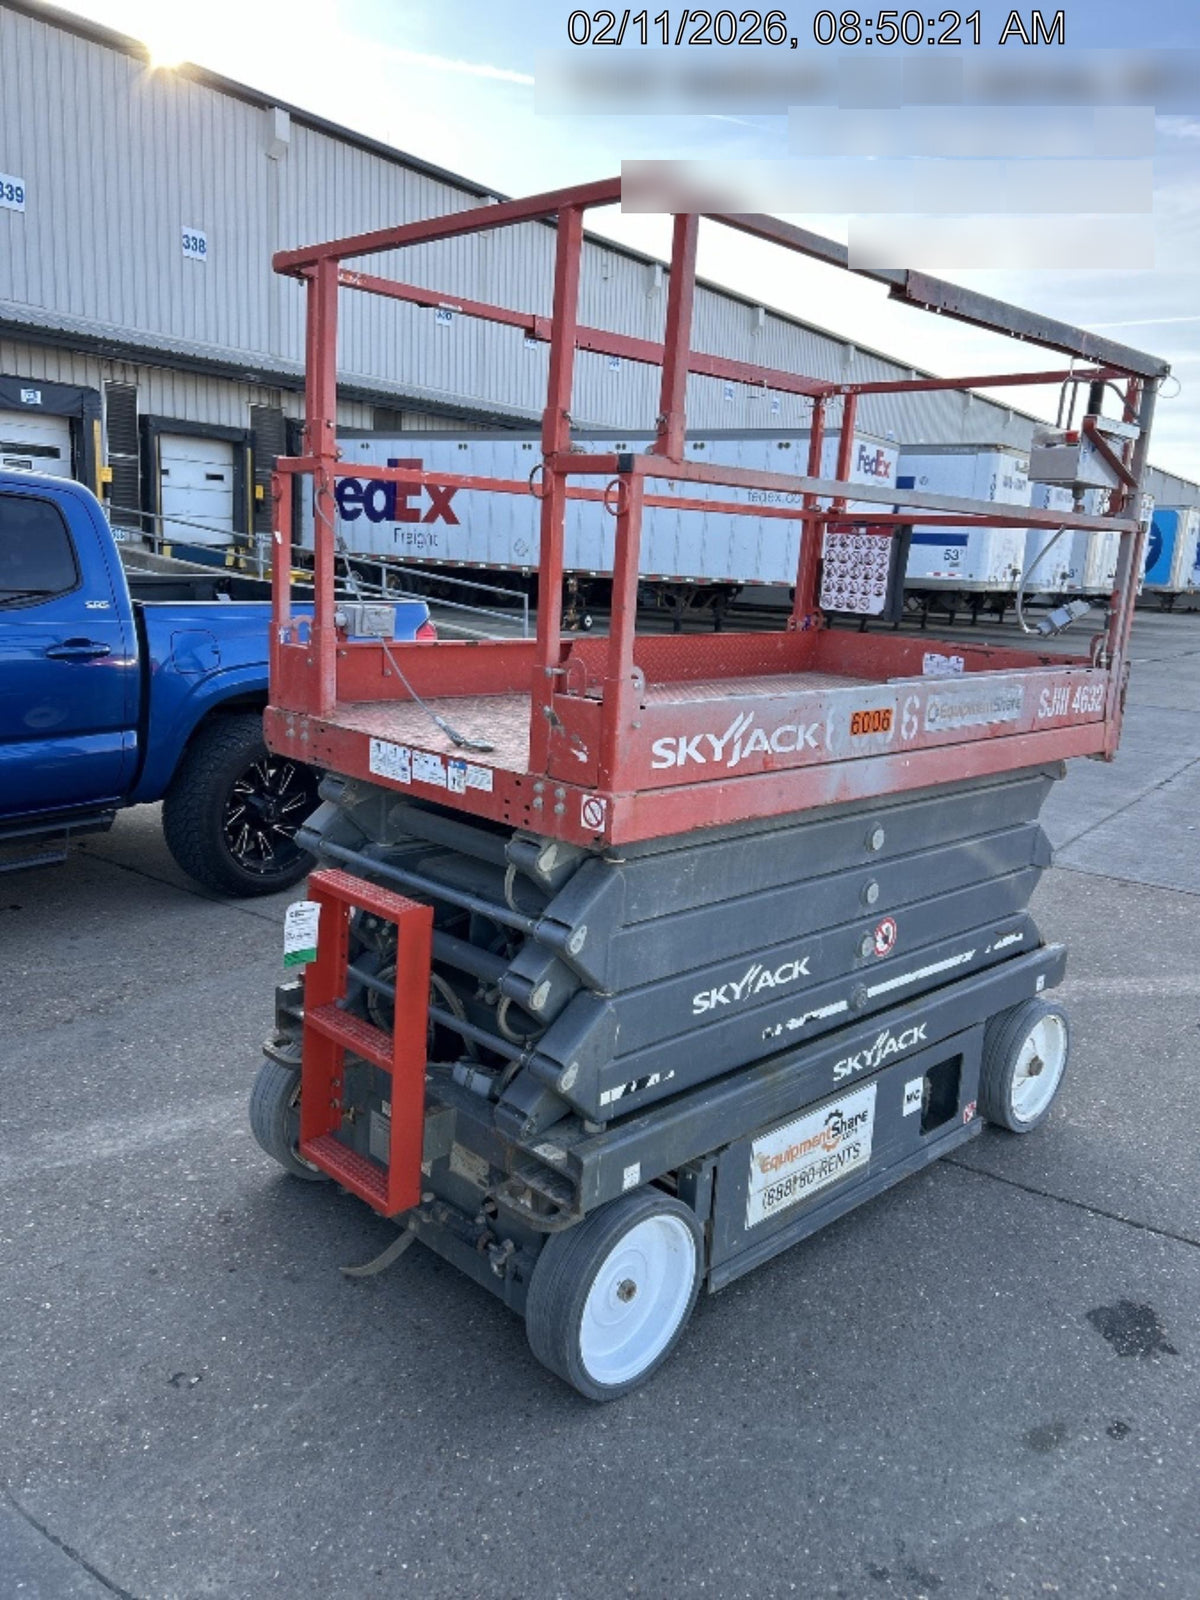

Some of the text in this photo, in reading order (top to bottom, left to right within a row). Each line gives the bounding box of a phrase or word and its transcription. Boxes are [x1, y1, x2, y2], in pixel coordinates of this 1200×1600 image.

[182, 234, 206, 254] 338
[857, 444, 892, 479] FedEx
[332, 458, 461, 525] edEx
[394, 528, 438, 548] Freight
[851, 708, 891, 735] 6006
[1072, 684, 1104, 714] 4632
[651, 710, 820, 769] SKYJACK
[692, 956, 812, 1015] SKYJACK
[833, 1022, 928, 1081] SKYJACK
[759, 1110, 868, 1174] EquipmentShare
